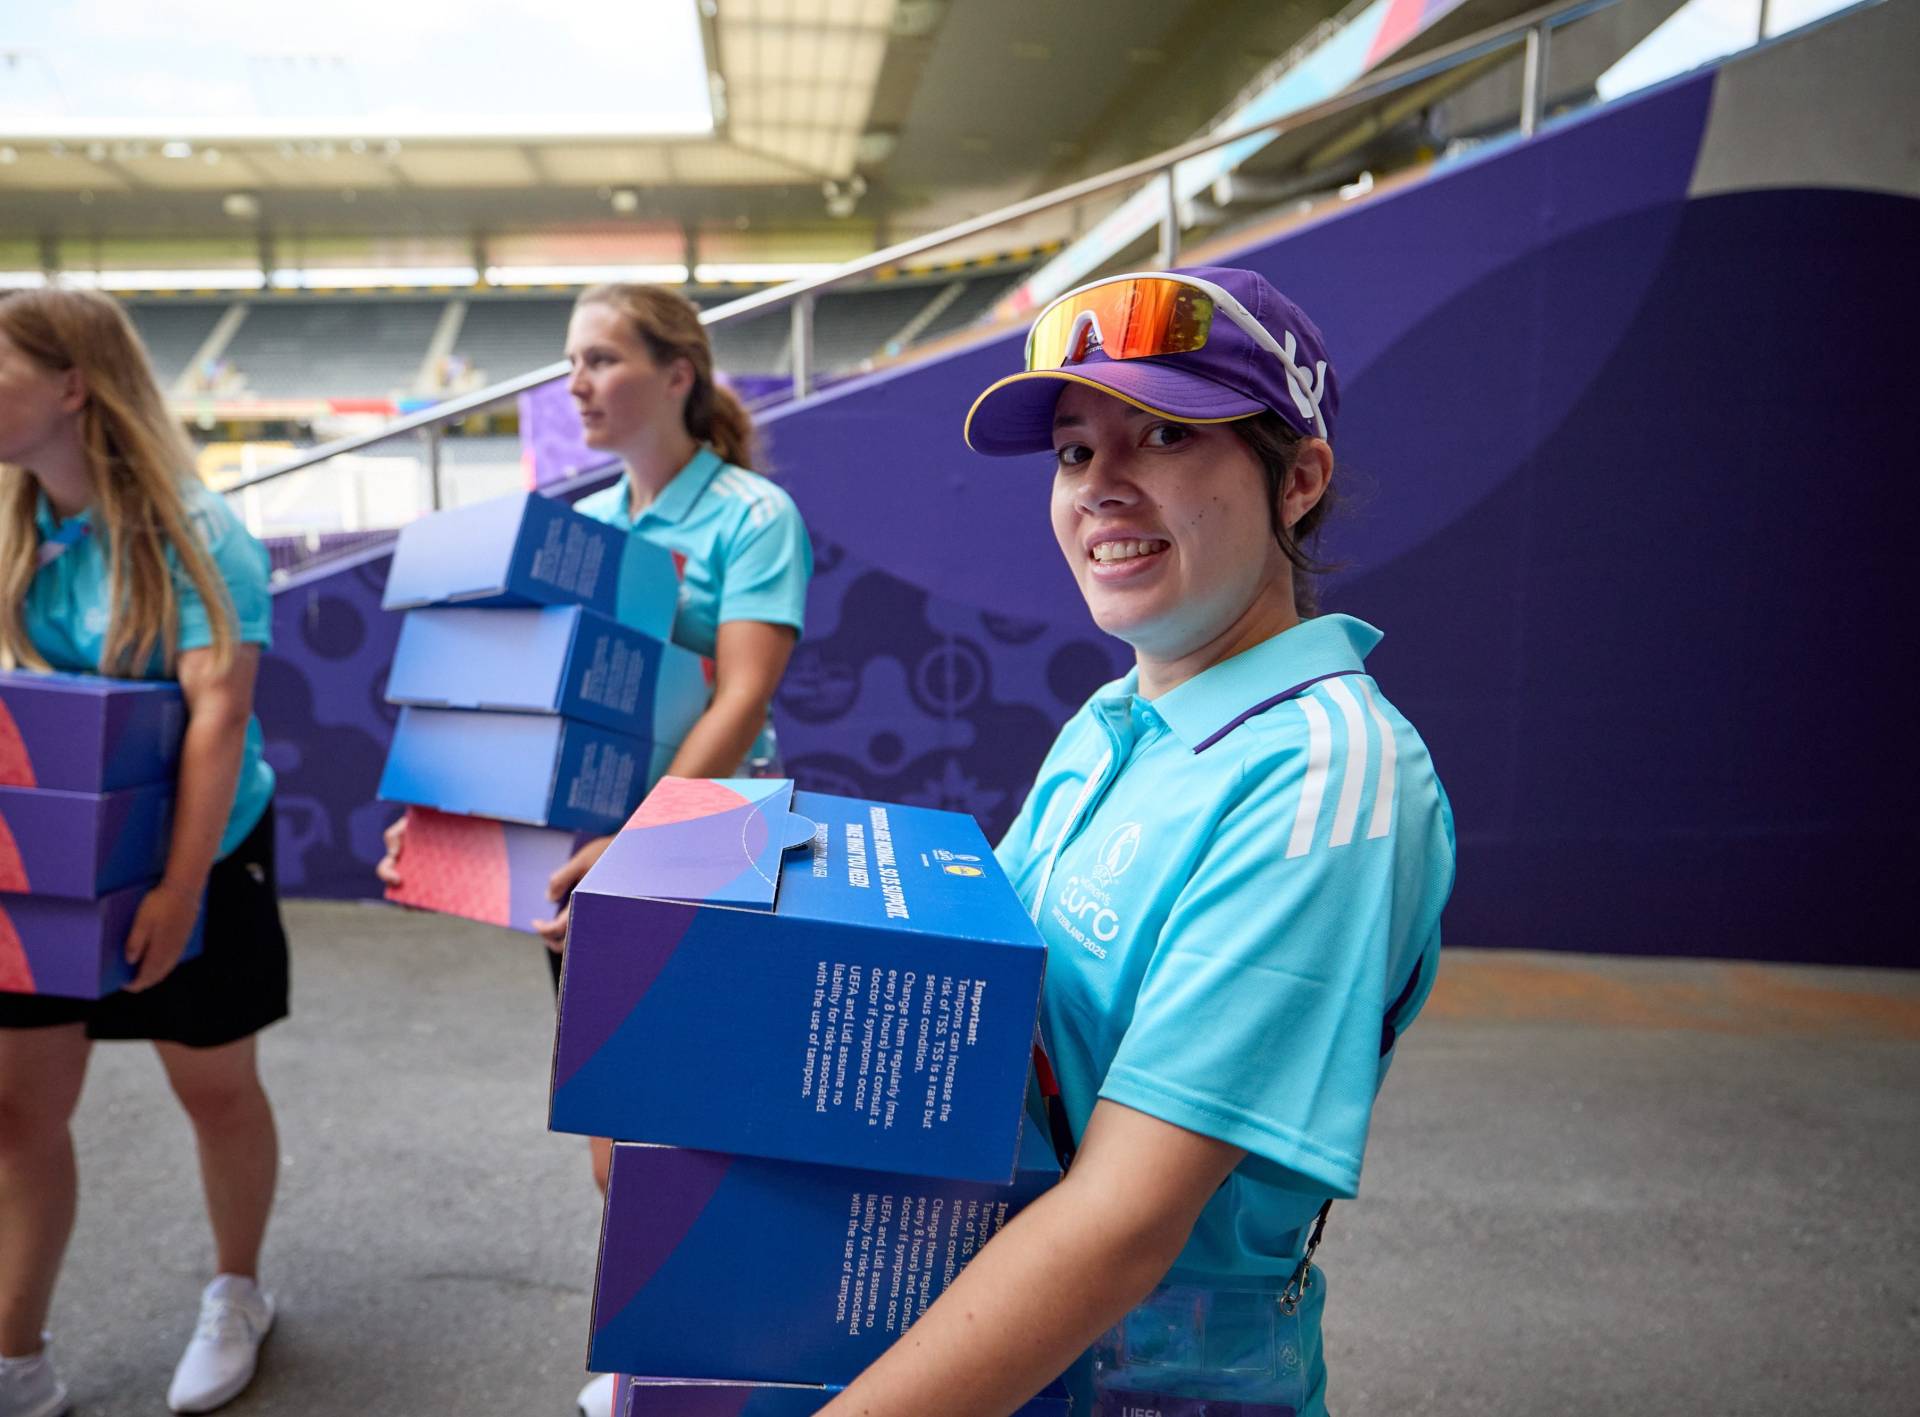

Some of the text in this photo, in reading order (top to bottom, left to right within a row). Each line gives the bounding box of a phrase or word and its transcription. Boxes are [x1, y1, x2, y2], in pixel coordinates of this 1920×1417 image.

[874, 829, 892, 841] ARE
[846, 824, 870, 888] TAKE WHAT YOU NEED!
[879, 868, 898, 878] SO
[880, 877, 900, 886] IS
[882, 885, 909, 919] SUPPORT.
[1083, 938, 1107, 960] 2025
[884, 970, 897, 1001] every
[941, 977, 953, 996] risk
[940, 999, 950, 1011] of
[967, 980, 986, 1045] Important:
[802, 961, 828, 1098] with the use of tampons.
[816, 963, 846, 1112] liability for risks associated
[833, 966, 861, 1105] UEFA and Lidl assume no
[855, 968, 883, 1111] doctor if symptoms occur.
[877, 1014, 894, 1049] hours)
[914, 974, 936, 1073] serious condition.
[936, 1014, 949, 1037] TSS.
[876, 1051, 886, 1073] and
[884, 972, 916, 1129] Change them regularly (max.
[932, 1041, 945, 1061] TSS
[940, 979, 970, 1122] Tampons can increase the
[930, 1064, 941, 1073] is
[870, 1075, 883, 1116] consult
[926, 1085, 936, 1107] rare
[923, 1109, 935, 1128] but
[913, 1197, 926, 1227] every
[950, 1200, 962, 1237] serious
[966, 1221, 975, 1232] of
[967, 1200, 978, 1219] risk
[836, 1193, 861, 1323] with the use of tampons.
[866, 1196, 893, 1328] UEFA and Lidl assume no
[907, 1238, 924, 1272] hours)
[916, 1199, 944, 1317] Change them regularly
[962, 1235, 975, 1257] TSS.
[849, 1194, 878, 1335] liability for risks associated
[886, 1196, 913, 1332] doctor if symptoms occur.
[906, 1274, 916, 1294] and
